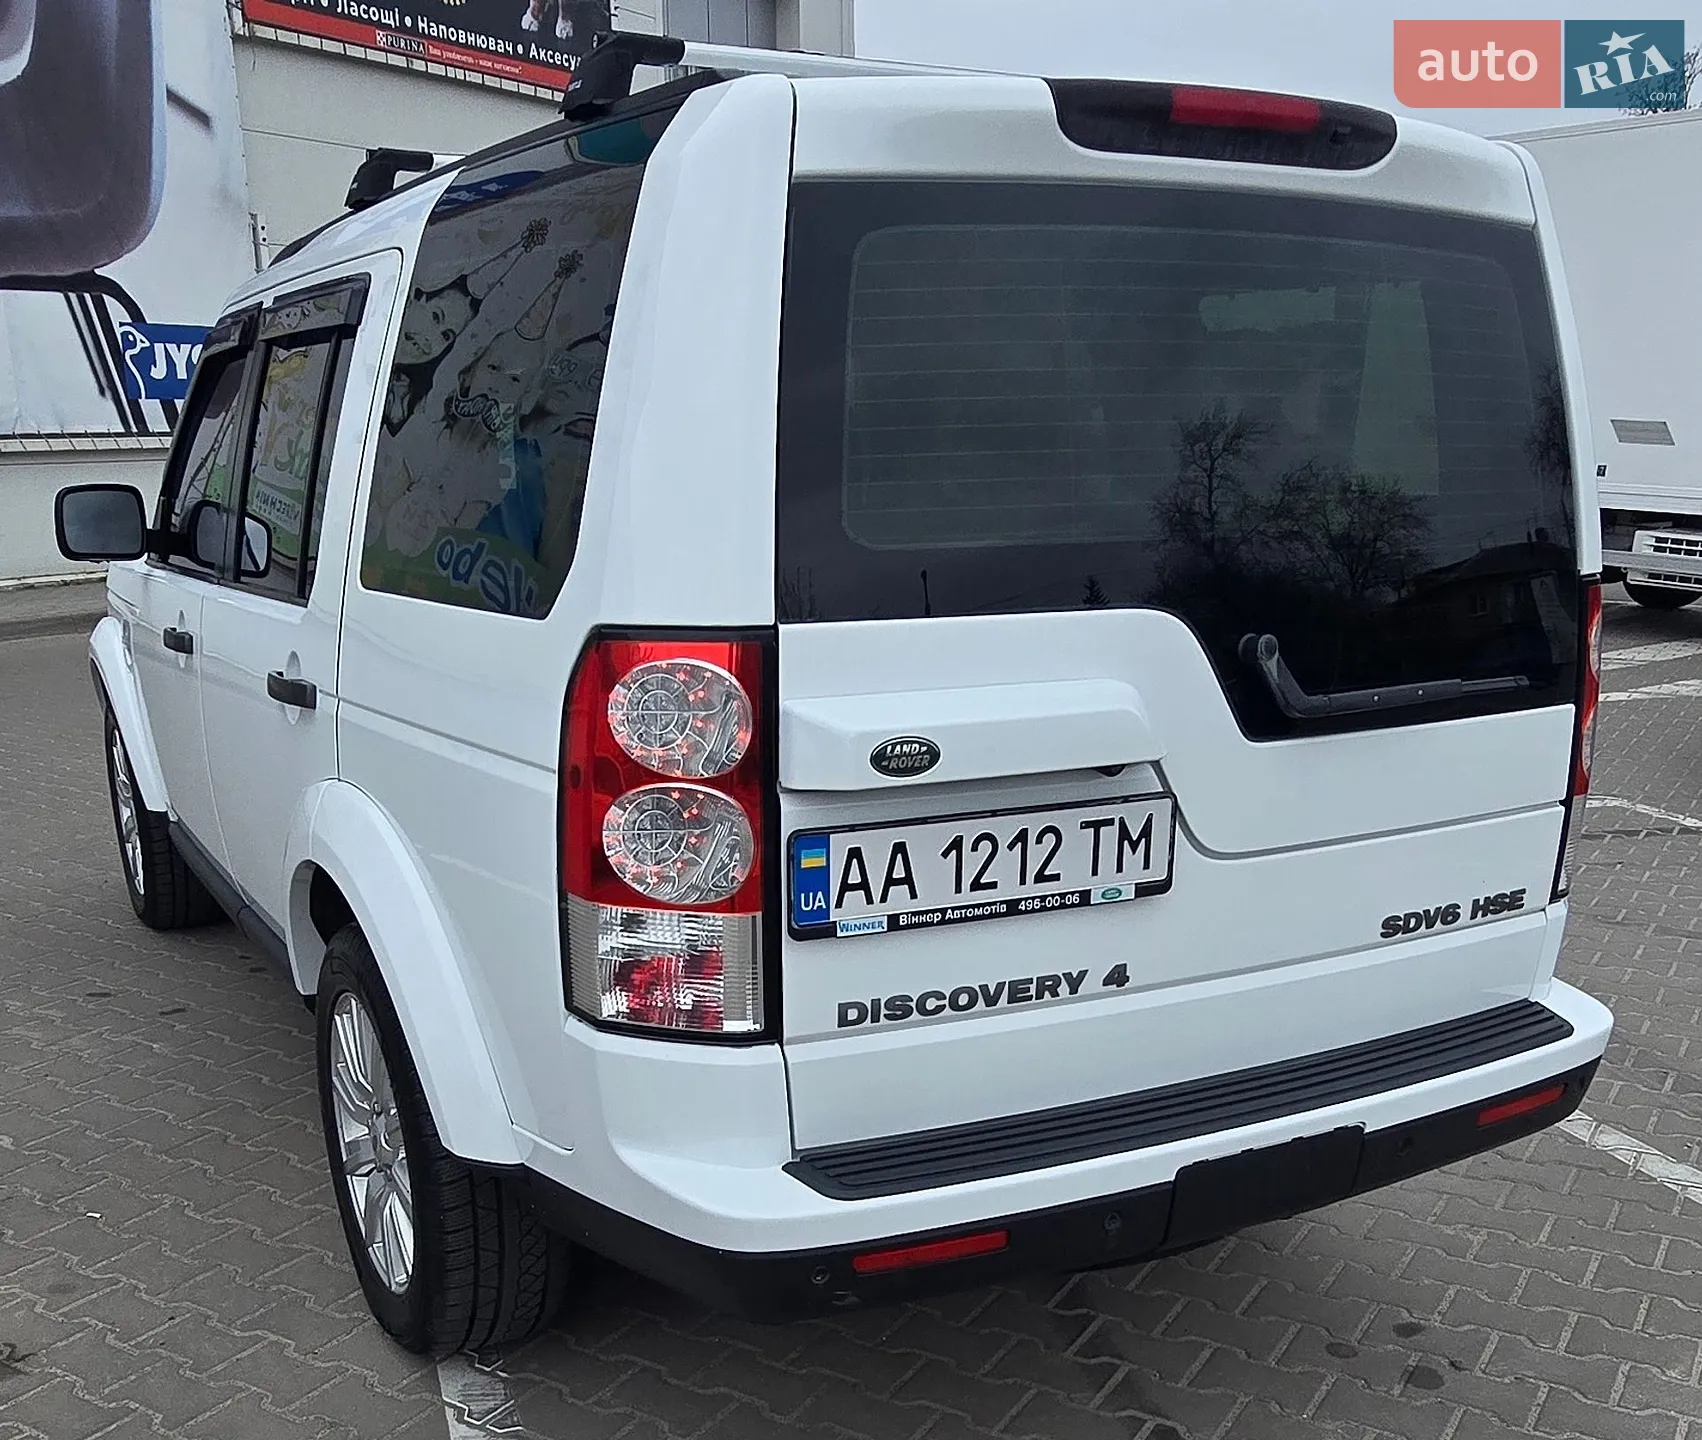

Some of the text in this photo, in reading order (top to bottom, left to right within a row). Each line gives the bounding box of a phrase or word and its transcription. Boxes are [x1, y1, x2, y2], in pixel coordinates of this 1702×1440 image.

[386, 33, 426, 55] PURINA
[417, 15, 513, 55] Наповнювач
[886, 743, 920, 757] LAND
[889, 754, 931, 769] ROVER
[833, 812, 1154, 910] AA 1212 TM
[800, 891, 826, 912] UA
[945, 904, 1007, 921] Автомотів
[1018, 893, 1080, 912] 496-00-06
[1380, 888, 1526, 939] SDV6 HSE
[836, 963, 1130, 1029] DISCOVERY 4
